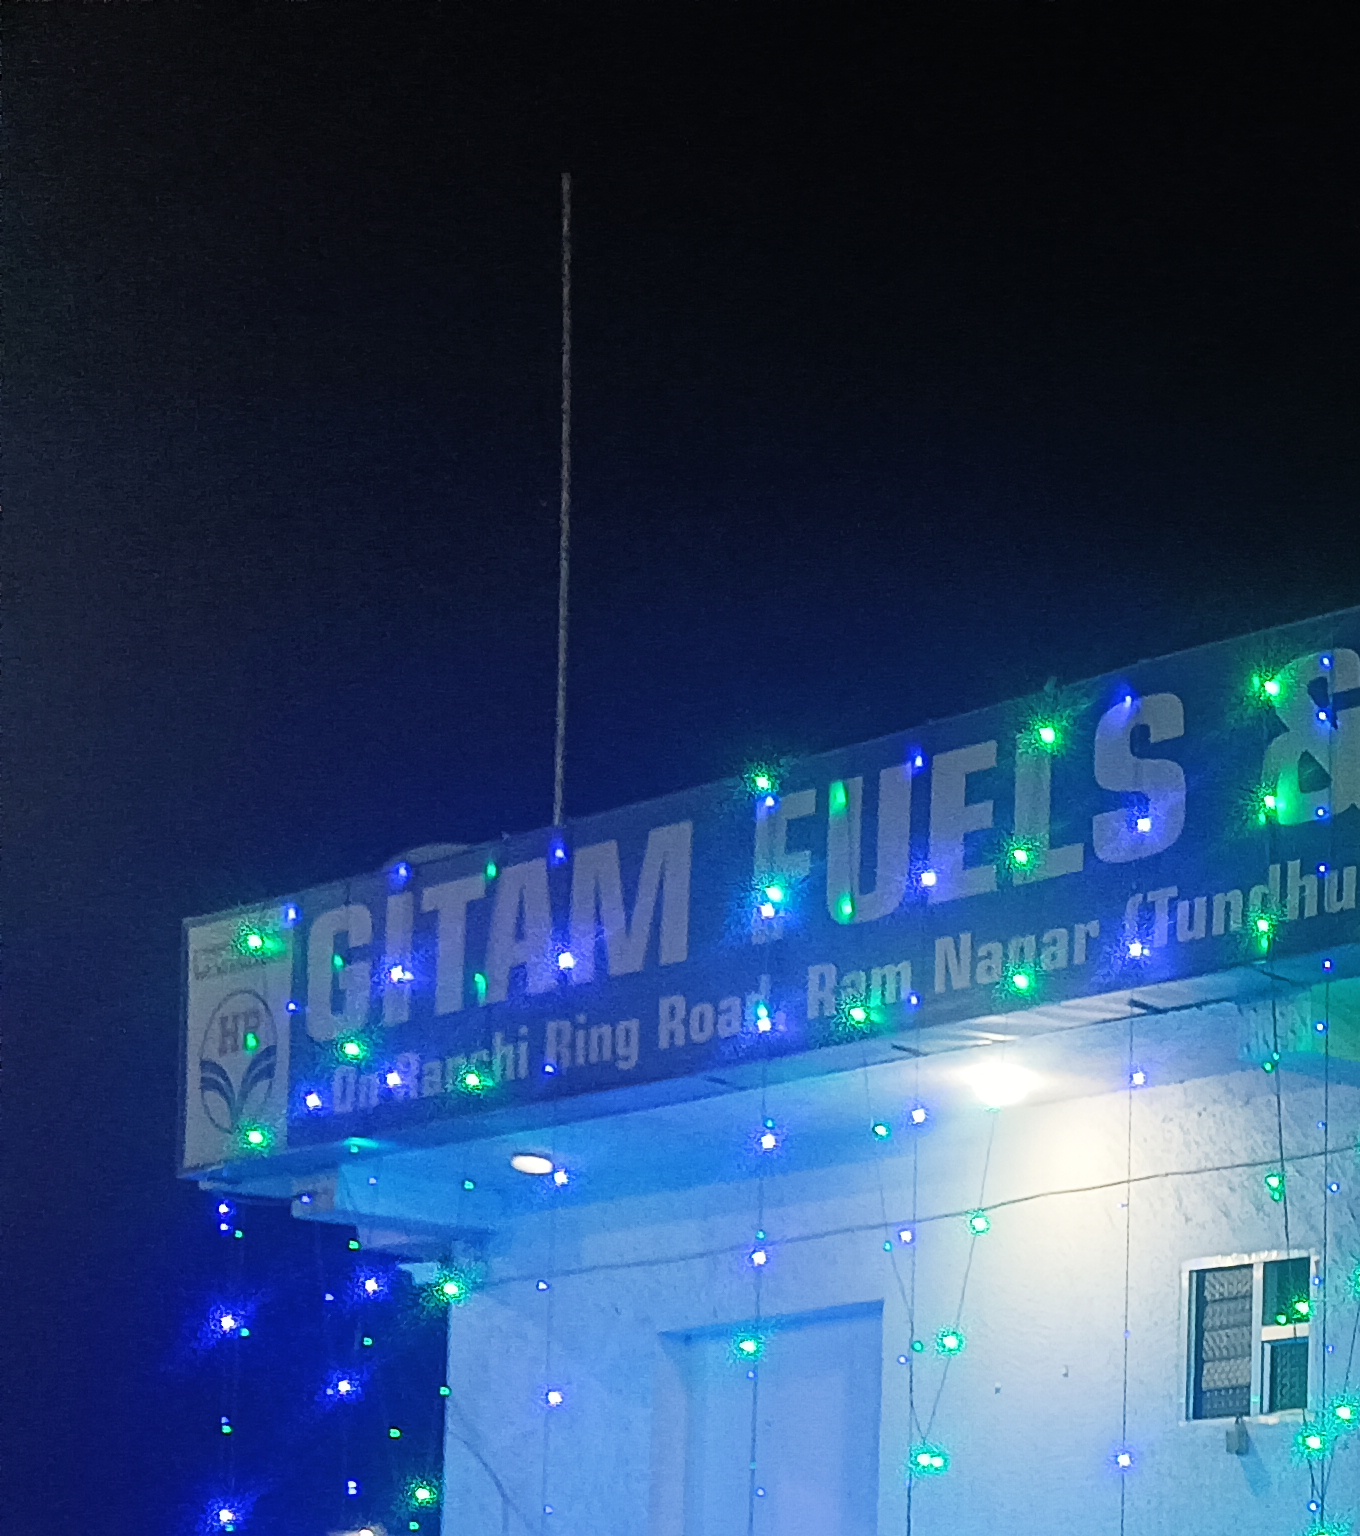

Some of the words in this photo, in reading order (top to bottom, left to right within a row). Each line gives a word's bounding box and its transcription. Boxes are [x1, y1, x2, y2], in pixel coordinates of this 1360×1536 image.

[306, 821, 694, 1042] GITAM
[753, 692, 1186, 943] FUELS
[218, 1009, 262, 1058] HP
[331, 1060, 380, 1115] On
[546, 1012, 640, 1071] Ring
[806, 959, 913, 1019] Ram
[933, 918, 1101, 996] Nagar
